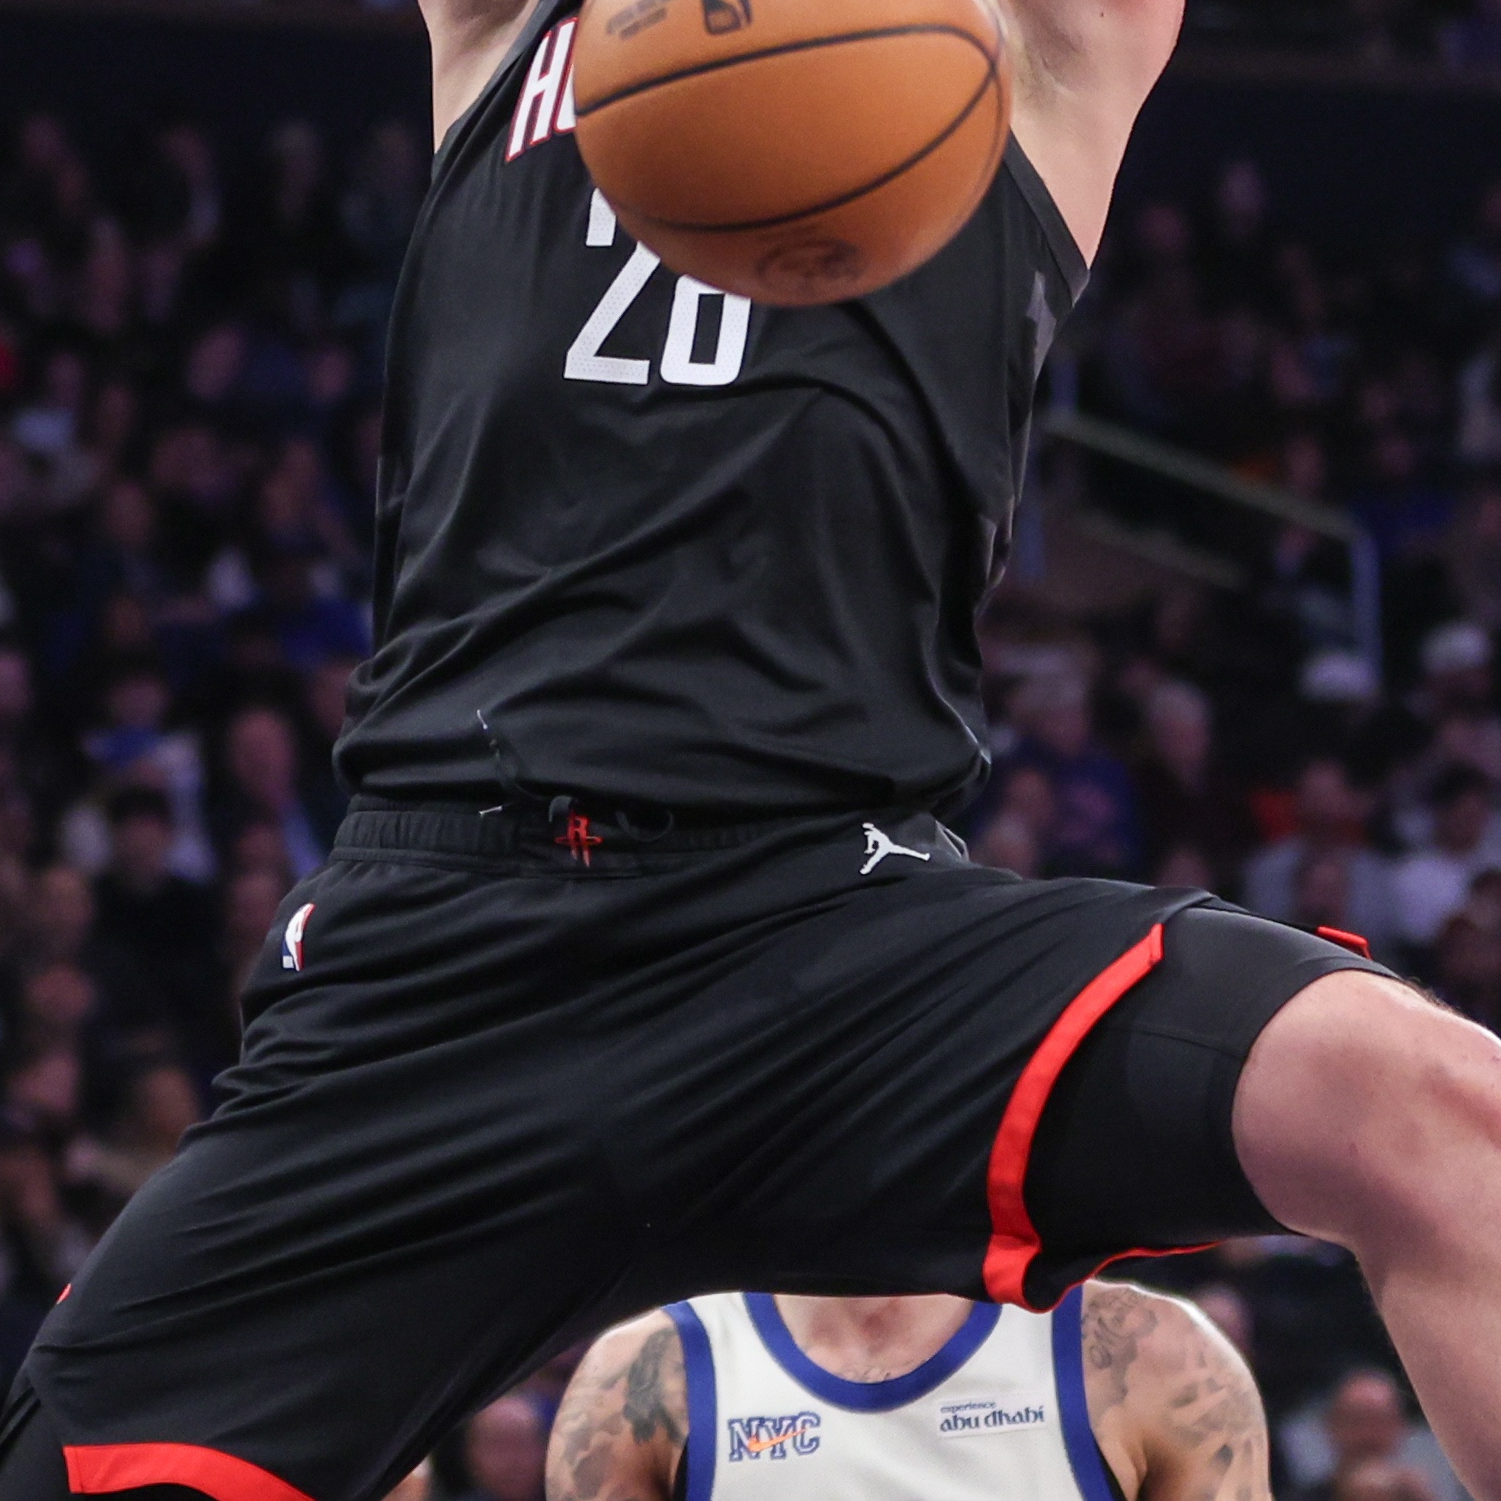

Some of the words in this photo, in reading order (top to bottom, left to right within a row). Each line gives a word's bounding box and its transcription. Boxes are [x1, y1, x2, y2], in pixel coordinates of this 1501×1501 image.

[940, 1402, 997, 1414] experience
[940, 1414, 980, 1432] abu
[984, 1405, 1045, 1428] dhabi
[727, 1411, 821, 1462] NYC
